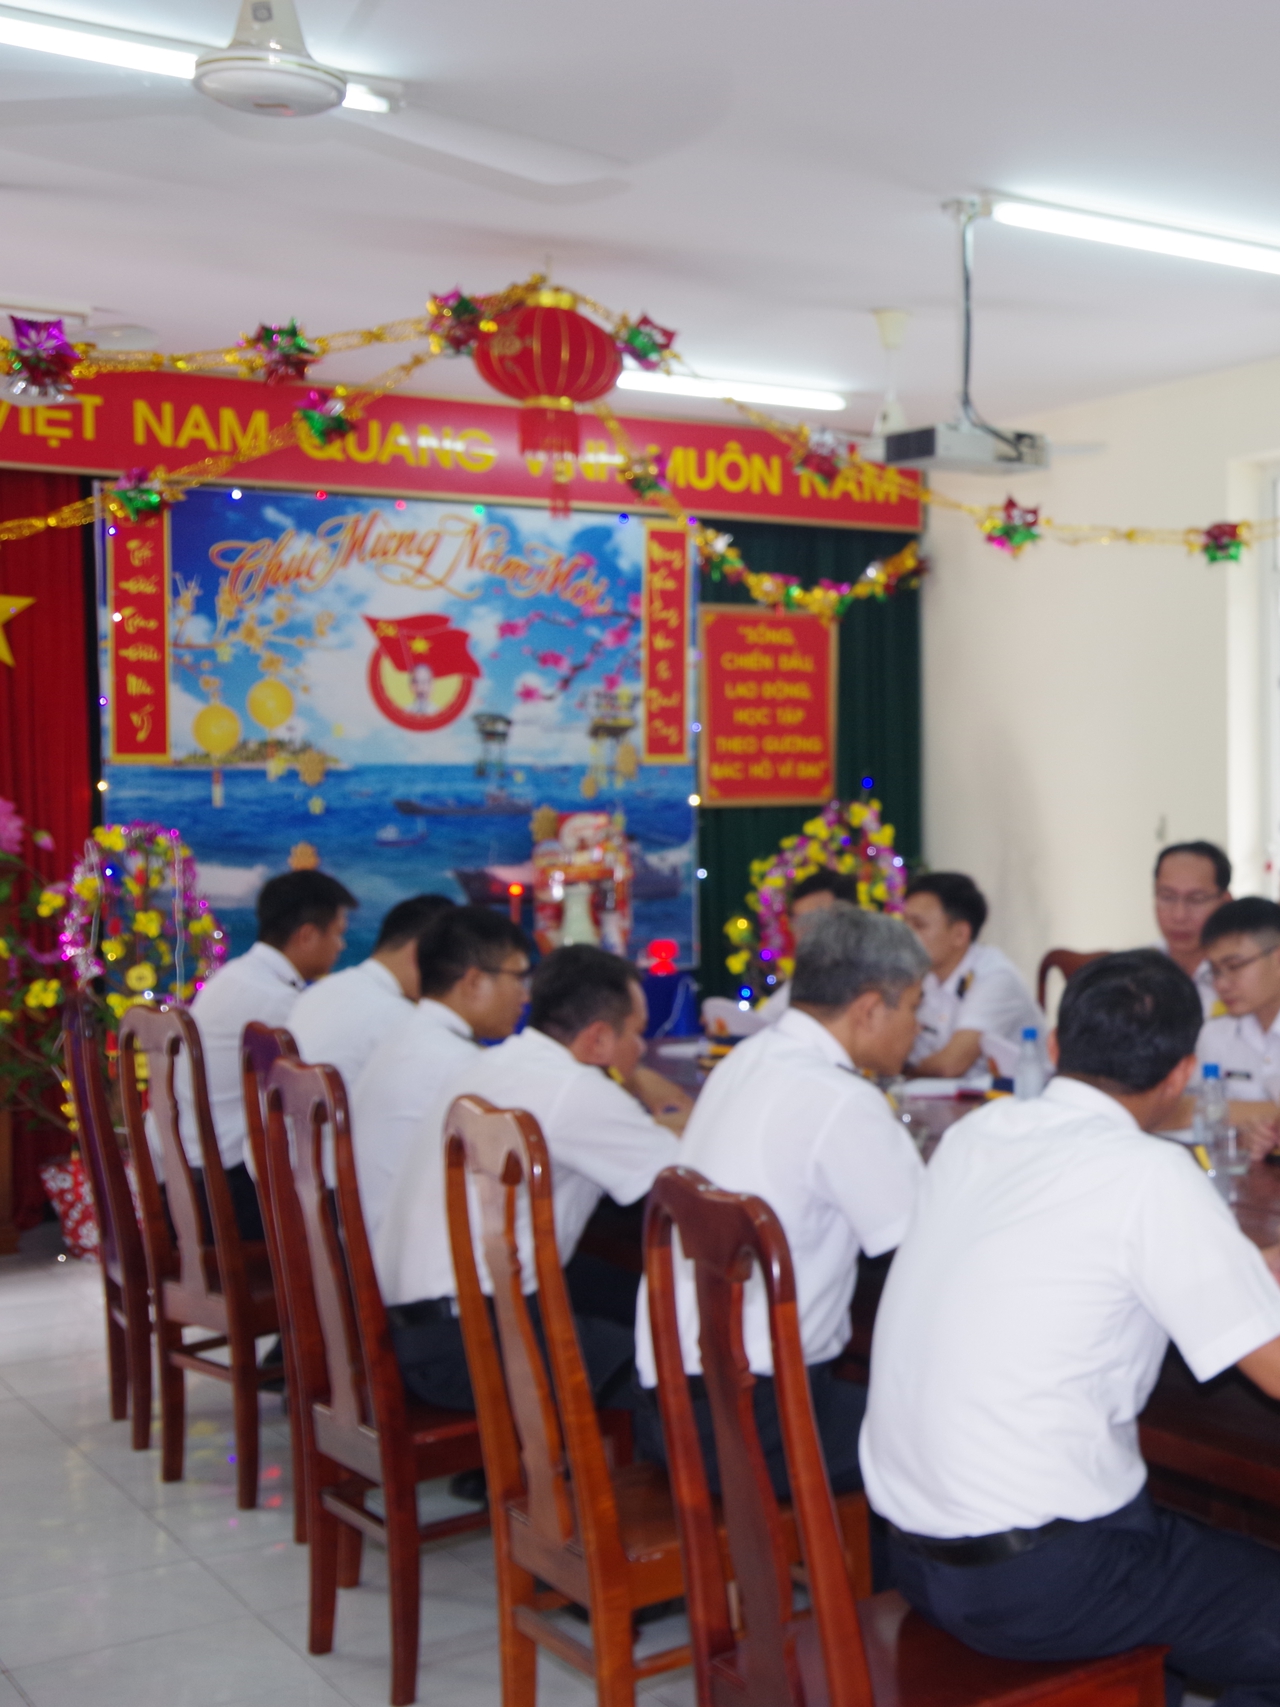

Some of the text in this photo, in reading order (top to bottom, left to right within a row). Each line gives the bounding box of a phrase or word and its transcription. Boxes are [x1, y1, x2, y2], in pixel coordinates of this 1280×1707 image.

[0, 393, 104, 448] IỆT
[133, 399, 269, 454] NAM
[296, 408, 498, 474] QUANG
[724, 681, 759, 699] LAO
[733, 706, 773, 727] HỌC
[715, 735, 759, 754] THEO
